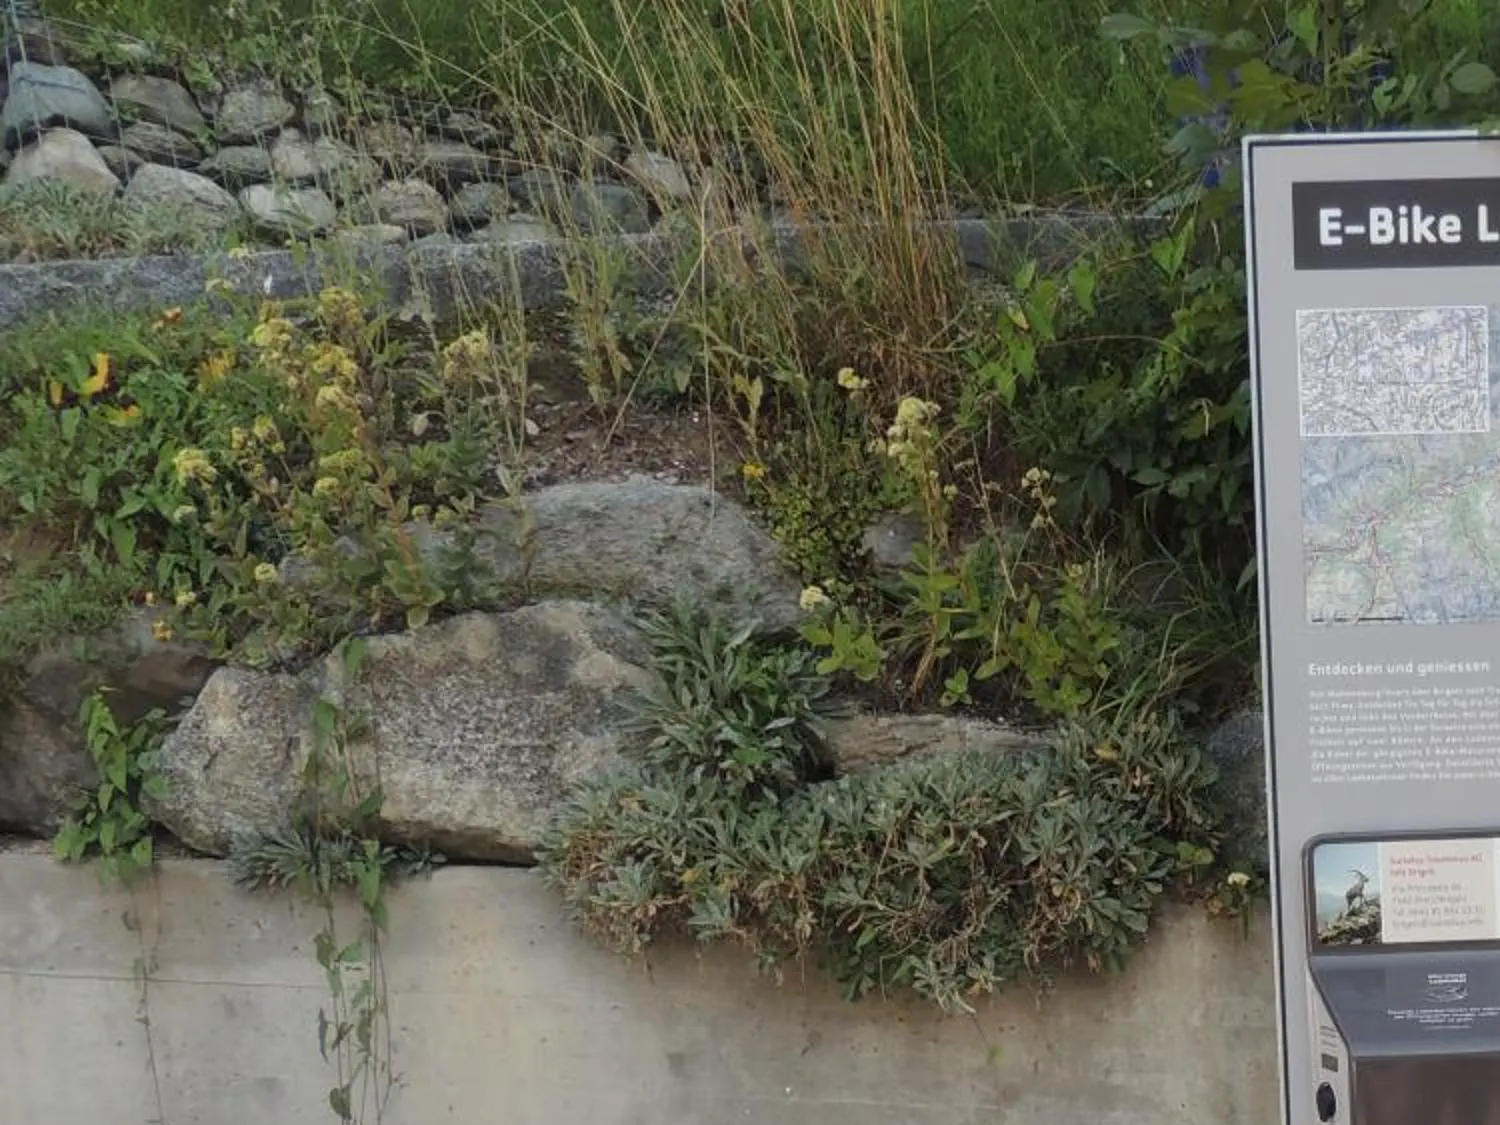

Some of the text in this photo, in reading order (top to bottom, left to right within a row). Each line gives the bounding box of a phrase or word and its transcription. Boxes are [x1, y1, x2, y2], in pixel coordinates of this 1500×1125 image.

[1318, 204, 1461, 246] E-Bike
[1308, 661, 1490, 676] Entdecken und geniessen
